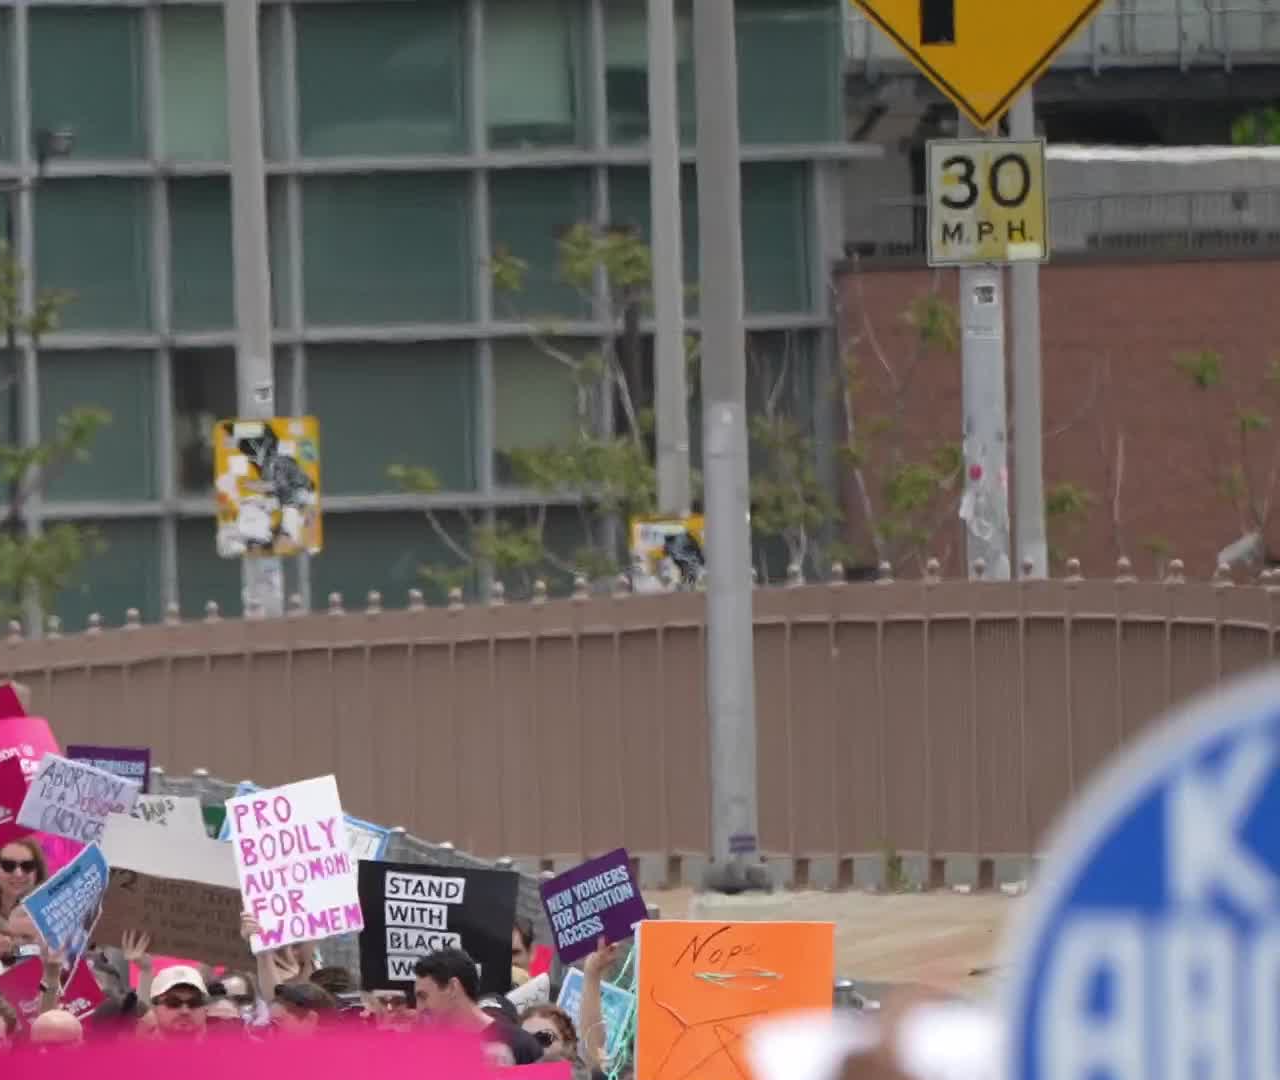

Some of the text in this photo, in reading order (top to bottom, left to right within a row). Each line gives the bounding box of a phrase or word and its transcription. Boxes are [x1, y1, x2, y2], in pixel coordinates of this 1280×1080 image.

[939, 152, 1031, 210] 30
[233, 796, 292, 834] PRO
[240, 816, 337, 866] BODILY
[251, 889, 306, 919] FOR
[389, 876, 460, 899] STAND
[546, 864, 630, 914] NEW YORKERS
[551, 881, 635, 932] FOR ABORTION
[257, 903, 362, 946] WOMEN
[389, 905, 443, 927] WITH
[558, 916, 604, 949] ACCESS
[389, 931, 458, 951] BLACK
